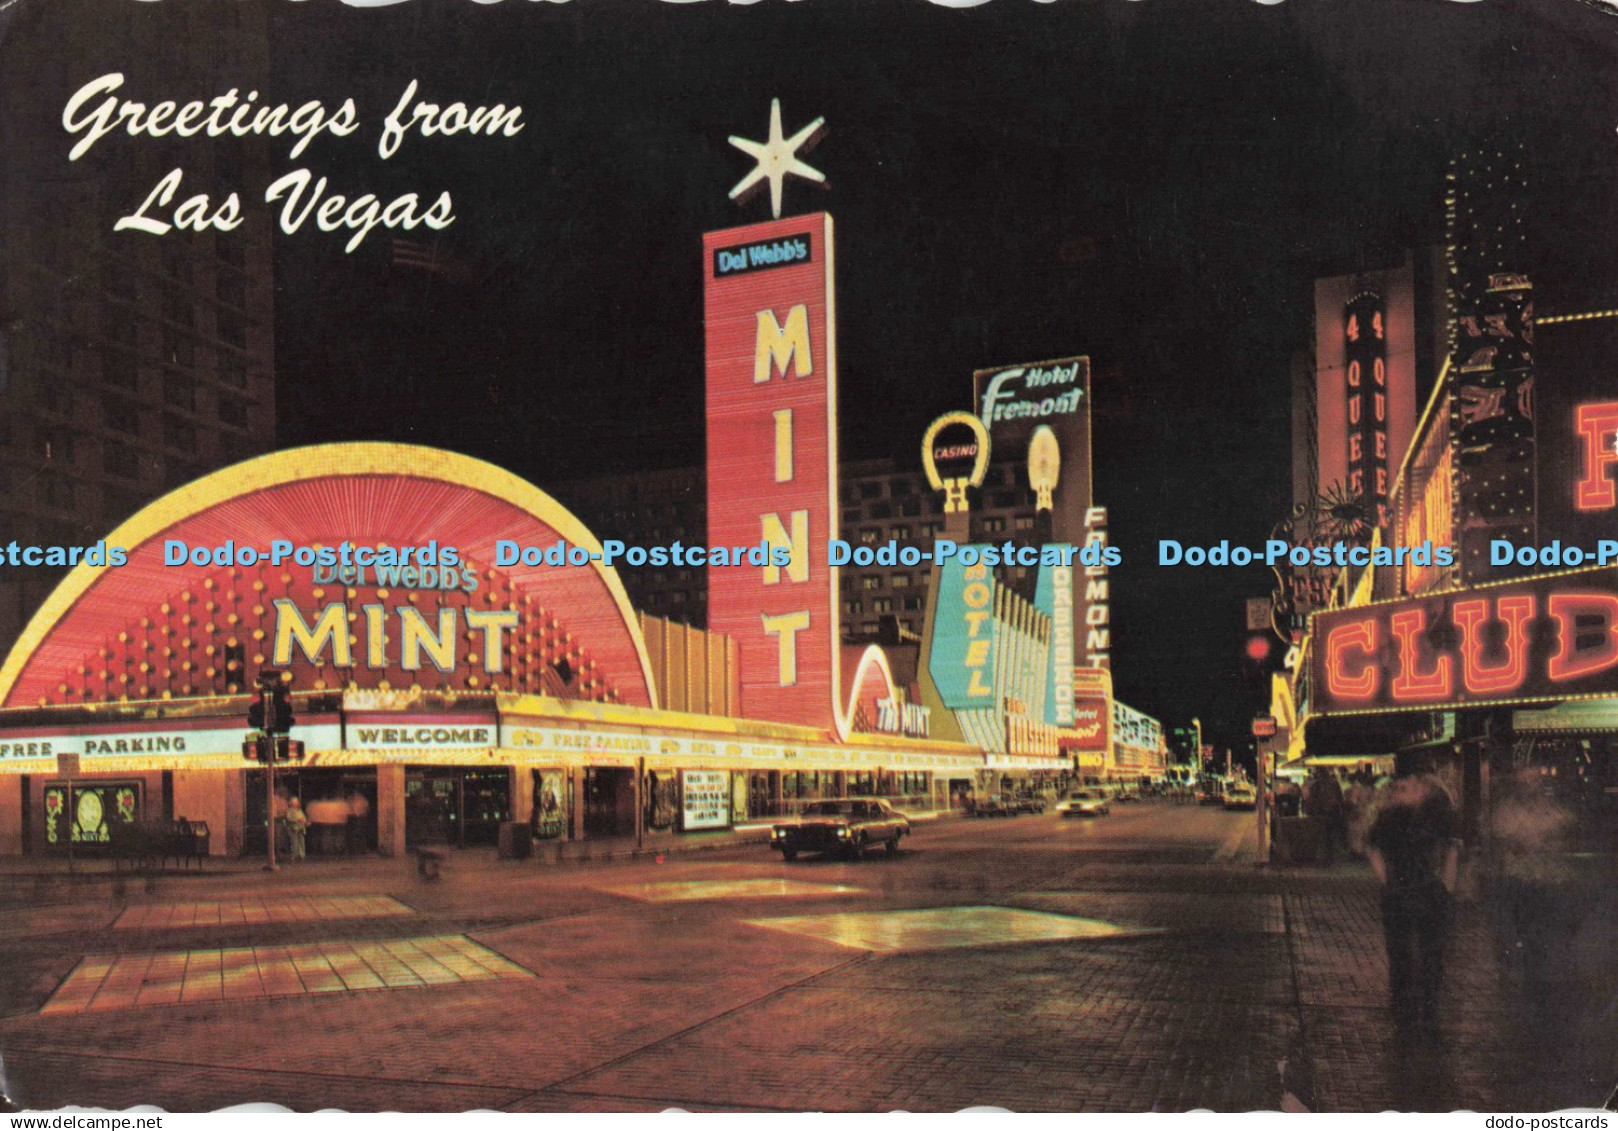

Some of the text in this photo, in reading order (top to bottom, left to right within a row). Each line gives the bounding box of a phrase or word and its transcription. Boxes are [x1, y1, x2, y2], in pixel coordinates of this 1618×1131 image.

[718, 239, 807, 272] Del Webb's
[1347, 313, 1359, 341] 4
[1372, 311, 1384, 339] 4
[1026, 362, 1079, 388] Hotel
[981, 368, 1084, 431] Fremont
[934, 445, 978, 460] CASINO
[754, 304, 813, 686] MINT
[273, 599, 519, 673] MINT
[1325, 594, 1618, 698] CLUB
[0, 737, 187, 758] FREE PARKING
[356, 727, 489, 745] WELCOME
[553, 732, 590, 748] FREE
